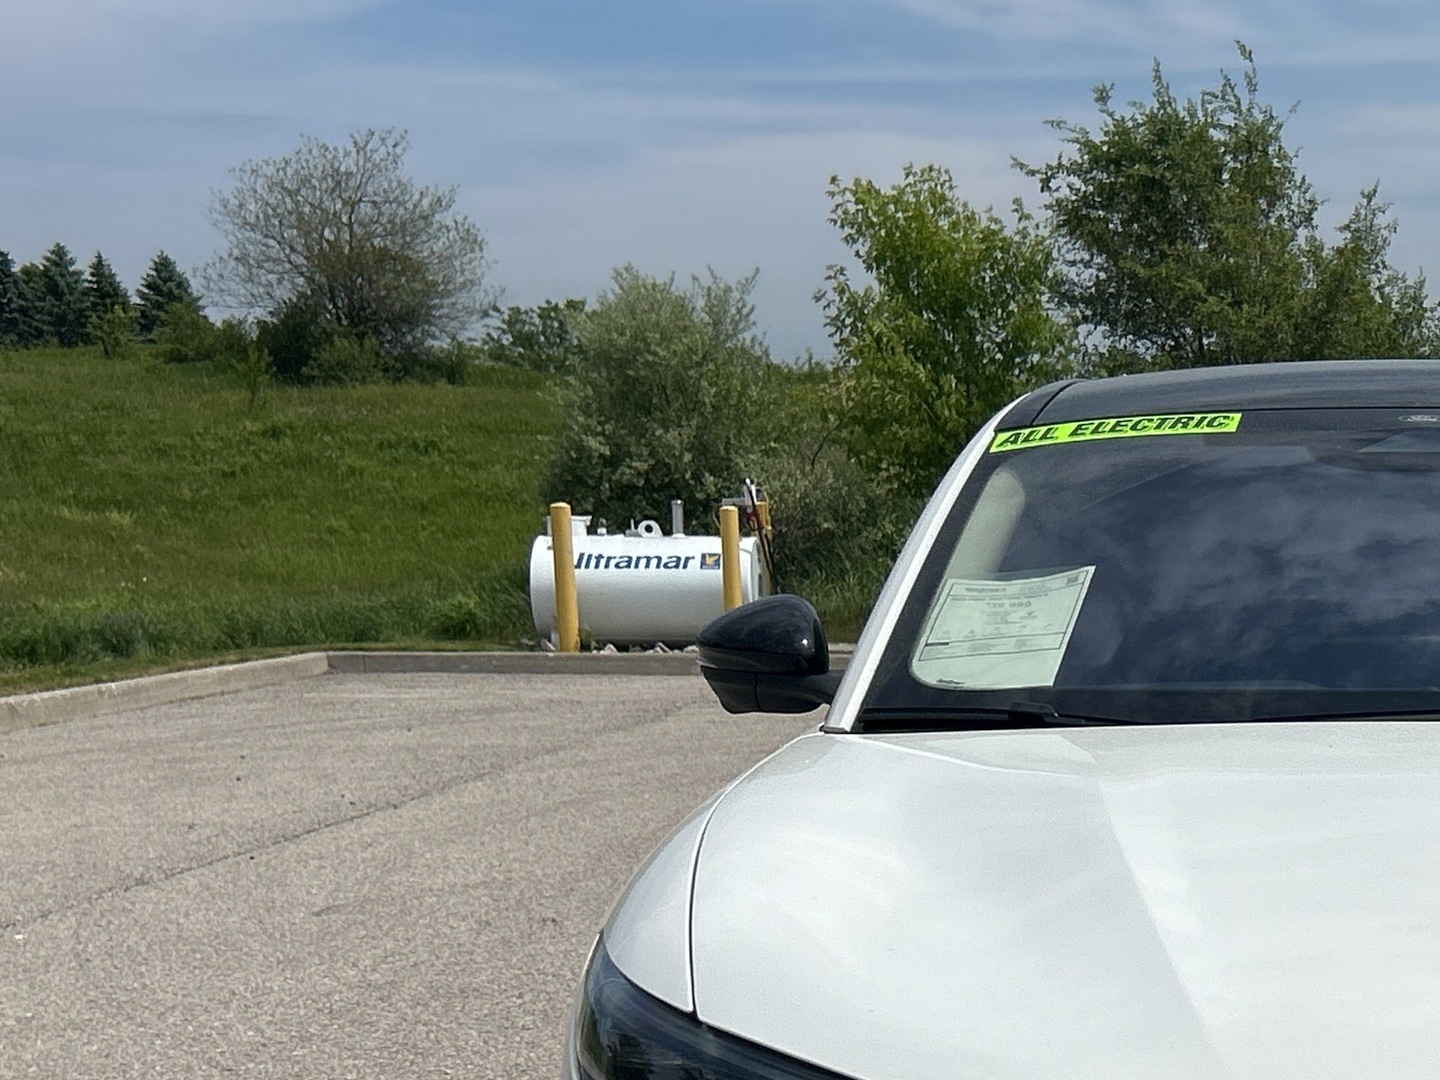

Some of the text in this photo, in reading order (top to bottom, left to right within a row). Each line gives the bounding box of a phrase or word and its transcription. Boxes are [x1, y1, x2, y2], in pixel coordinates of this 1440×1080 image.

[1407, 414, 1438, 422] Ford
[998, 415, 1233, 447] ALL ELECTRIC
